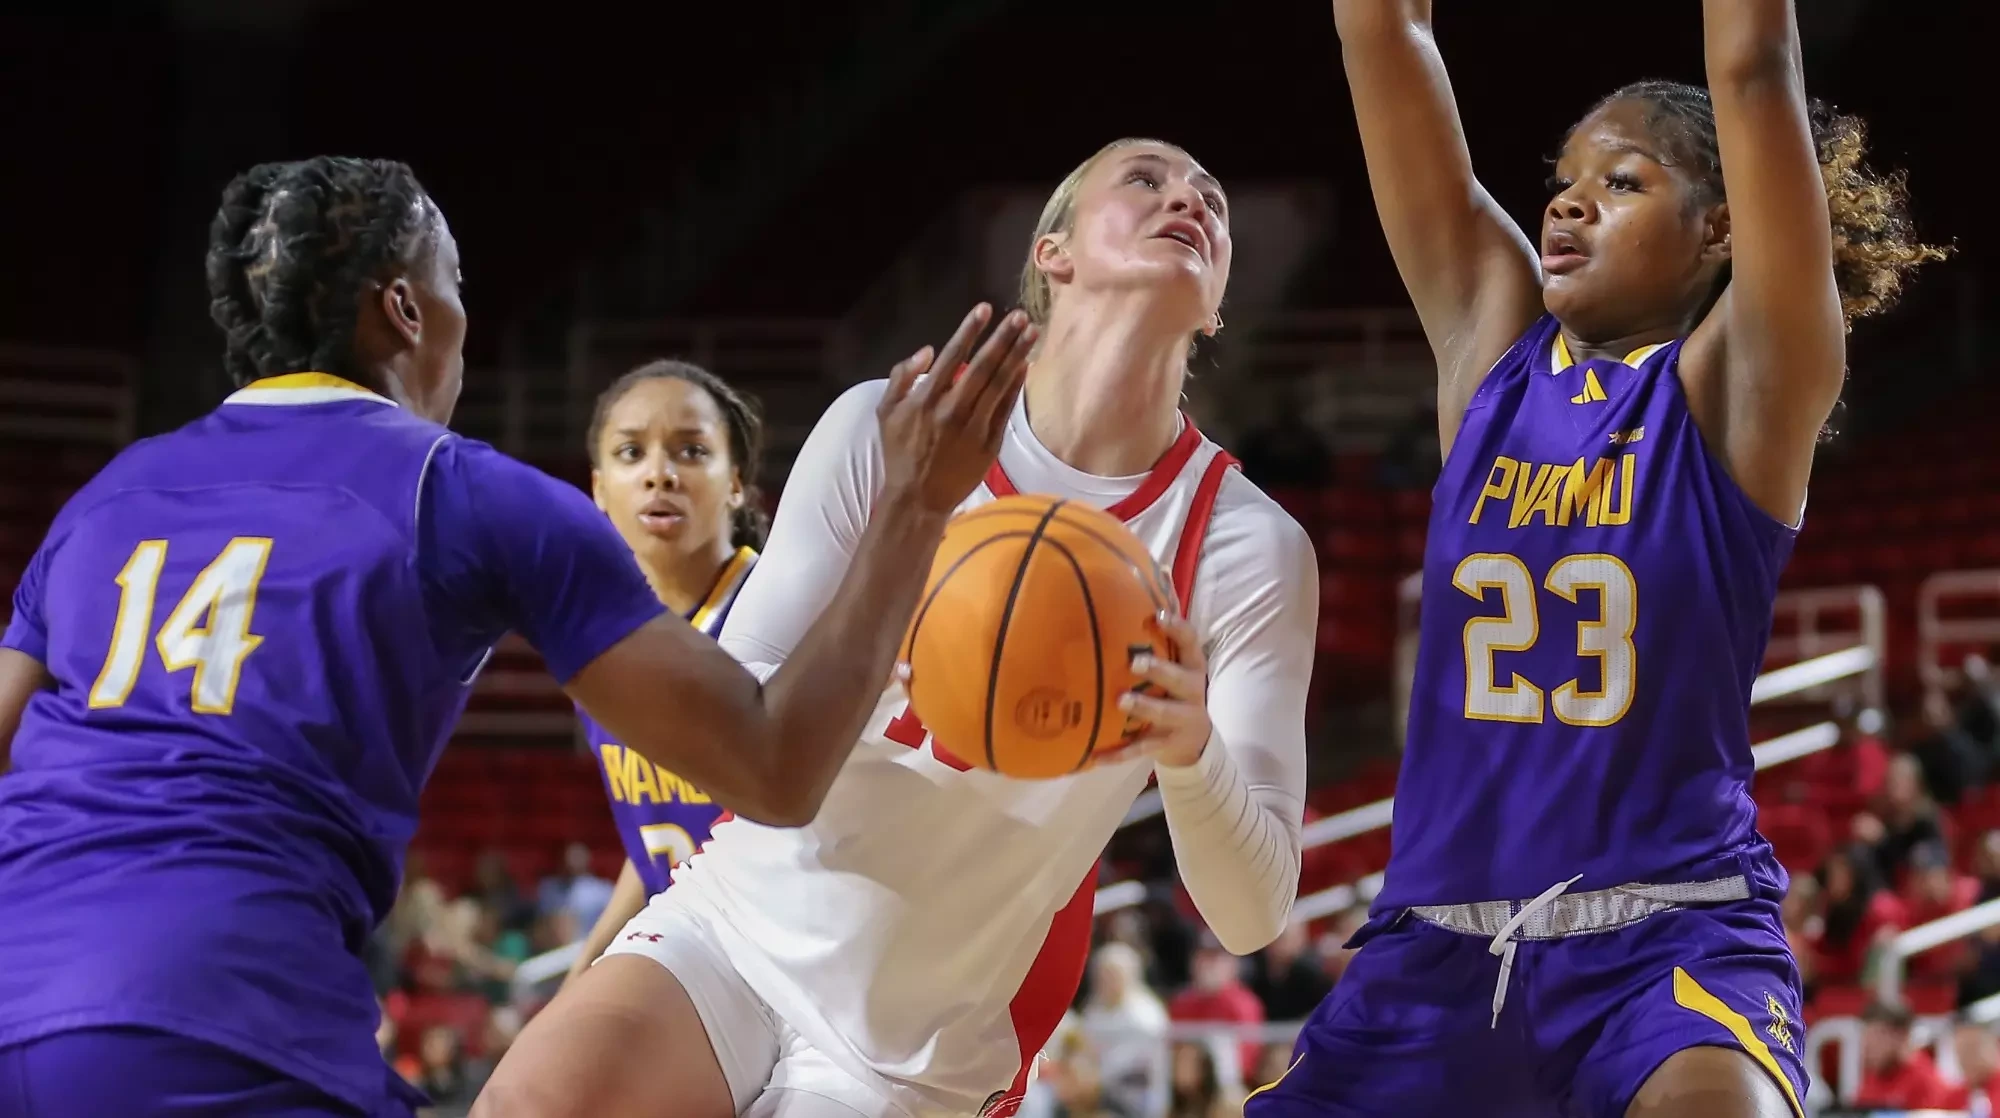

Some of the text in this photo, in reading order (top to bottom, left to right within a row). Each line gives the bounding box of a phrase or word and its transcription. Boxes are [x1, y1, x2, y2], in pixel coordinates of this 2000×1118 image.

[1469, 453, 1636, 528] PVAMU
[88, 537, 273, 715] 14
[1453, 553, 1638, 726] 23
